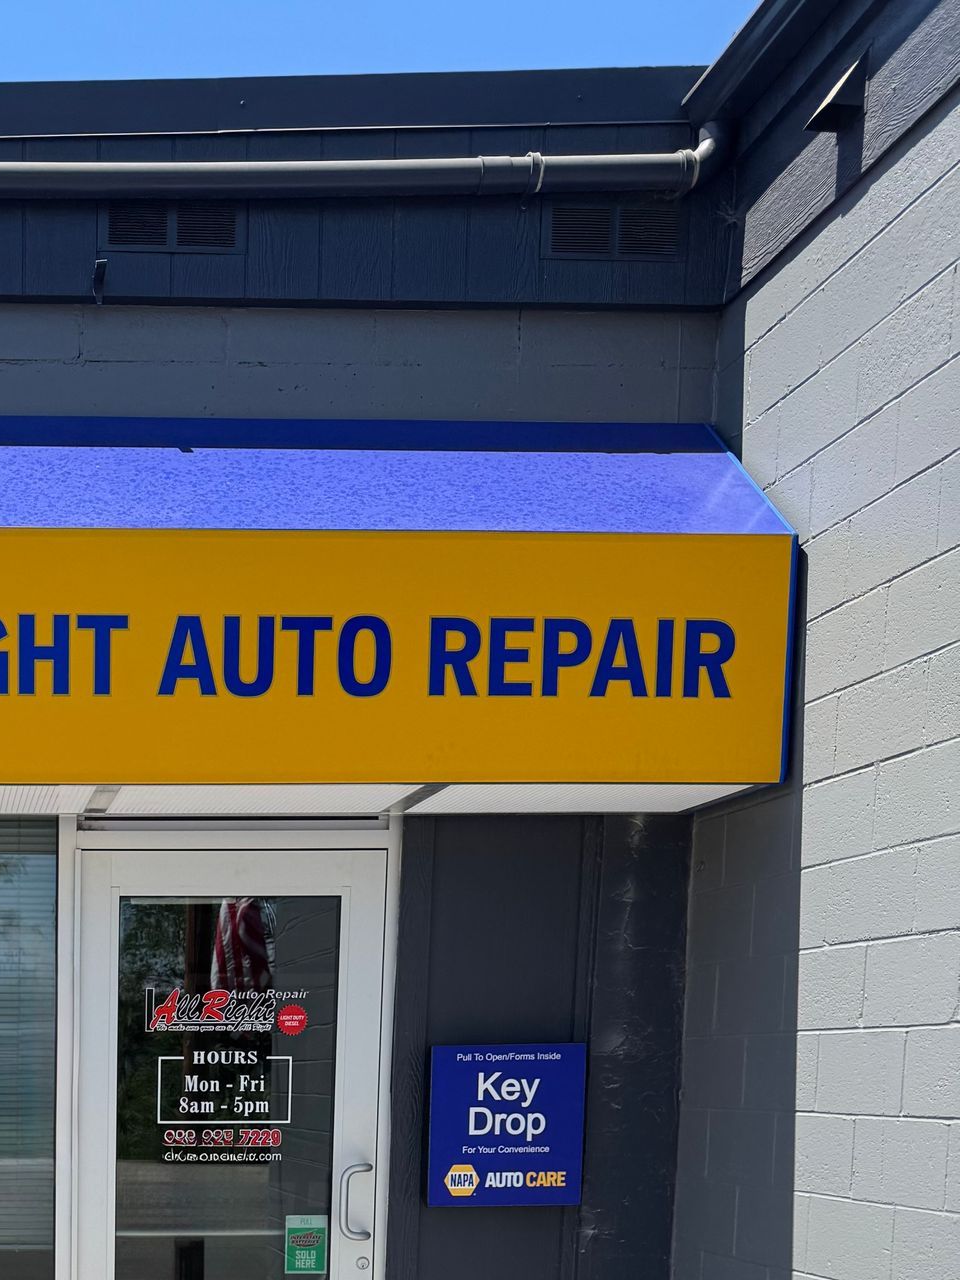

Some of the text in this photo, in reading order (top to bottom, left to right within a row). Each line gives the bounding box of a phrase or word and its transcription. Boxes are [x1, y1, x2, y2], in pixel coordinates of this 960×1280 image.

[157, 613, 395, 698] AUTO
[427, 616, 737, 700] REPAIR
[229, 988, 309, 1001] Auto Repair
[193, 1051, 258, 1065] HOURS
[456, 1052, 562, 1062] Pull To Open/Forms Inside
[184, 1075, 220, 1092] Mon
[239, 1075, 265, 1092] Fri
[477, 1071, 541, 1108] Key
[179, 1096, 214, 1113] 8am
[233, 1097, 269, 1116] 5pm
[468, 1106, 547, 1142] Drop
[239, 1129, 282, 1147] 7229
[462, 1145, 550, 1154] For Your Convenience
[449, 1173, 475, 1187] NAPA
[484, 1171, 567, 1188] AUTO CARE
[295, 1250, 317, 1259] SOLD
[295, 1259, 316, 1268] HERE
